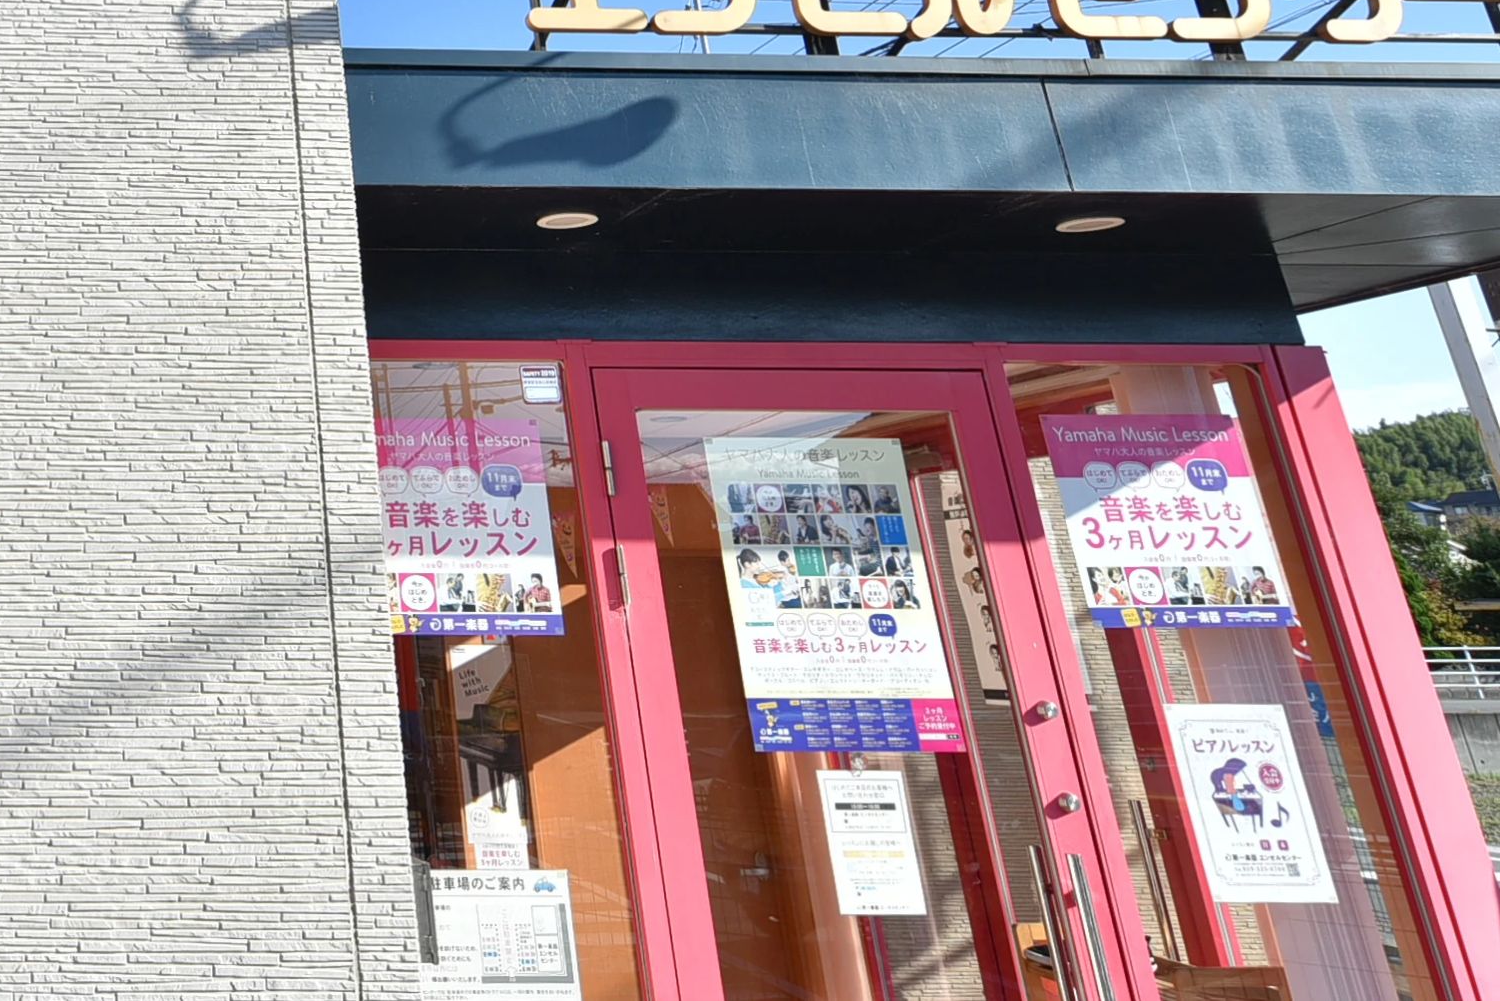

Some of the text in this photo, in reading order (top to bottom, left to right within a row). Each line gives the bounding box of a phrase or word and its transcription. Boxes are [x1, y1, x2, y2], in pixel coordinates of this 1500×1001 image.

[421, 431, 469, 447] Music
[475, 432, 530, 447] Lesson
[1052, 426, 1229, 442] Yamaha Music Lesson
[724, 447, 885, 462] ヤマハ大人の音楽レッスン
[757, 468, 860, 479] Yamaha Music Lesson
[1086, 469, 1114, 477] はじめて
[1190, 466, 1222, 478] 11月末
[385, 500, 531, 529] 音楽を楽しむ
[1099, 494, 1242, 523] 音楽を楽しむ
[1175, 610, 1221, 624] 第一楽器
[443, 618, 489, 631] 第一楽器
[458, 669, 476, 680] Life
[461, 677, 482, 689] with
[464, 684, 490, 697] Music
[1192, 738, 1275, 753] ピアノレッスン
